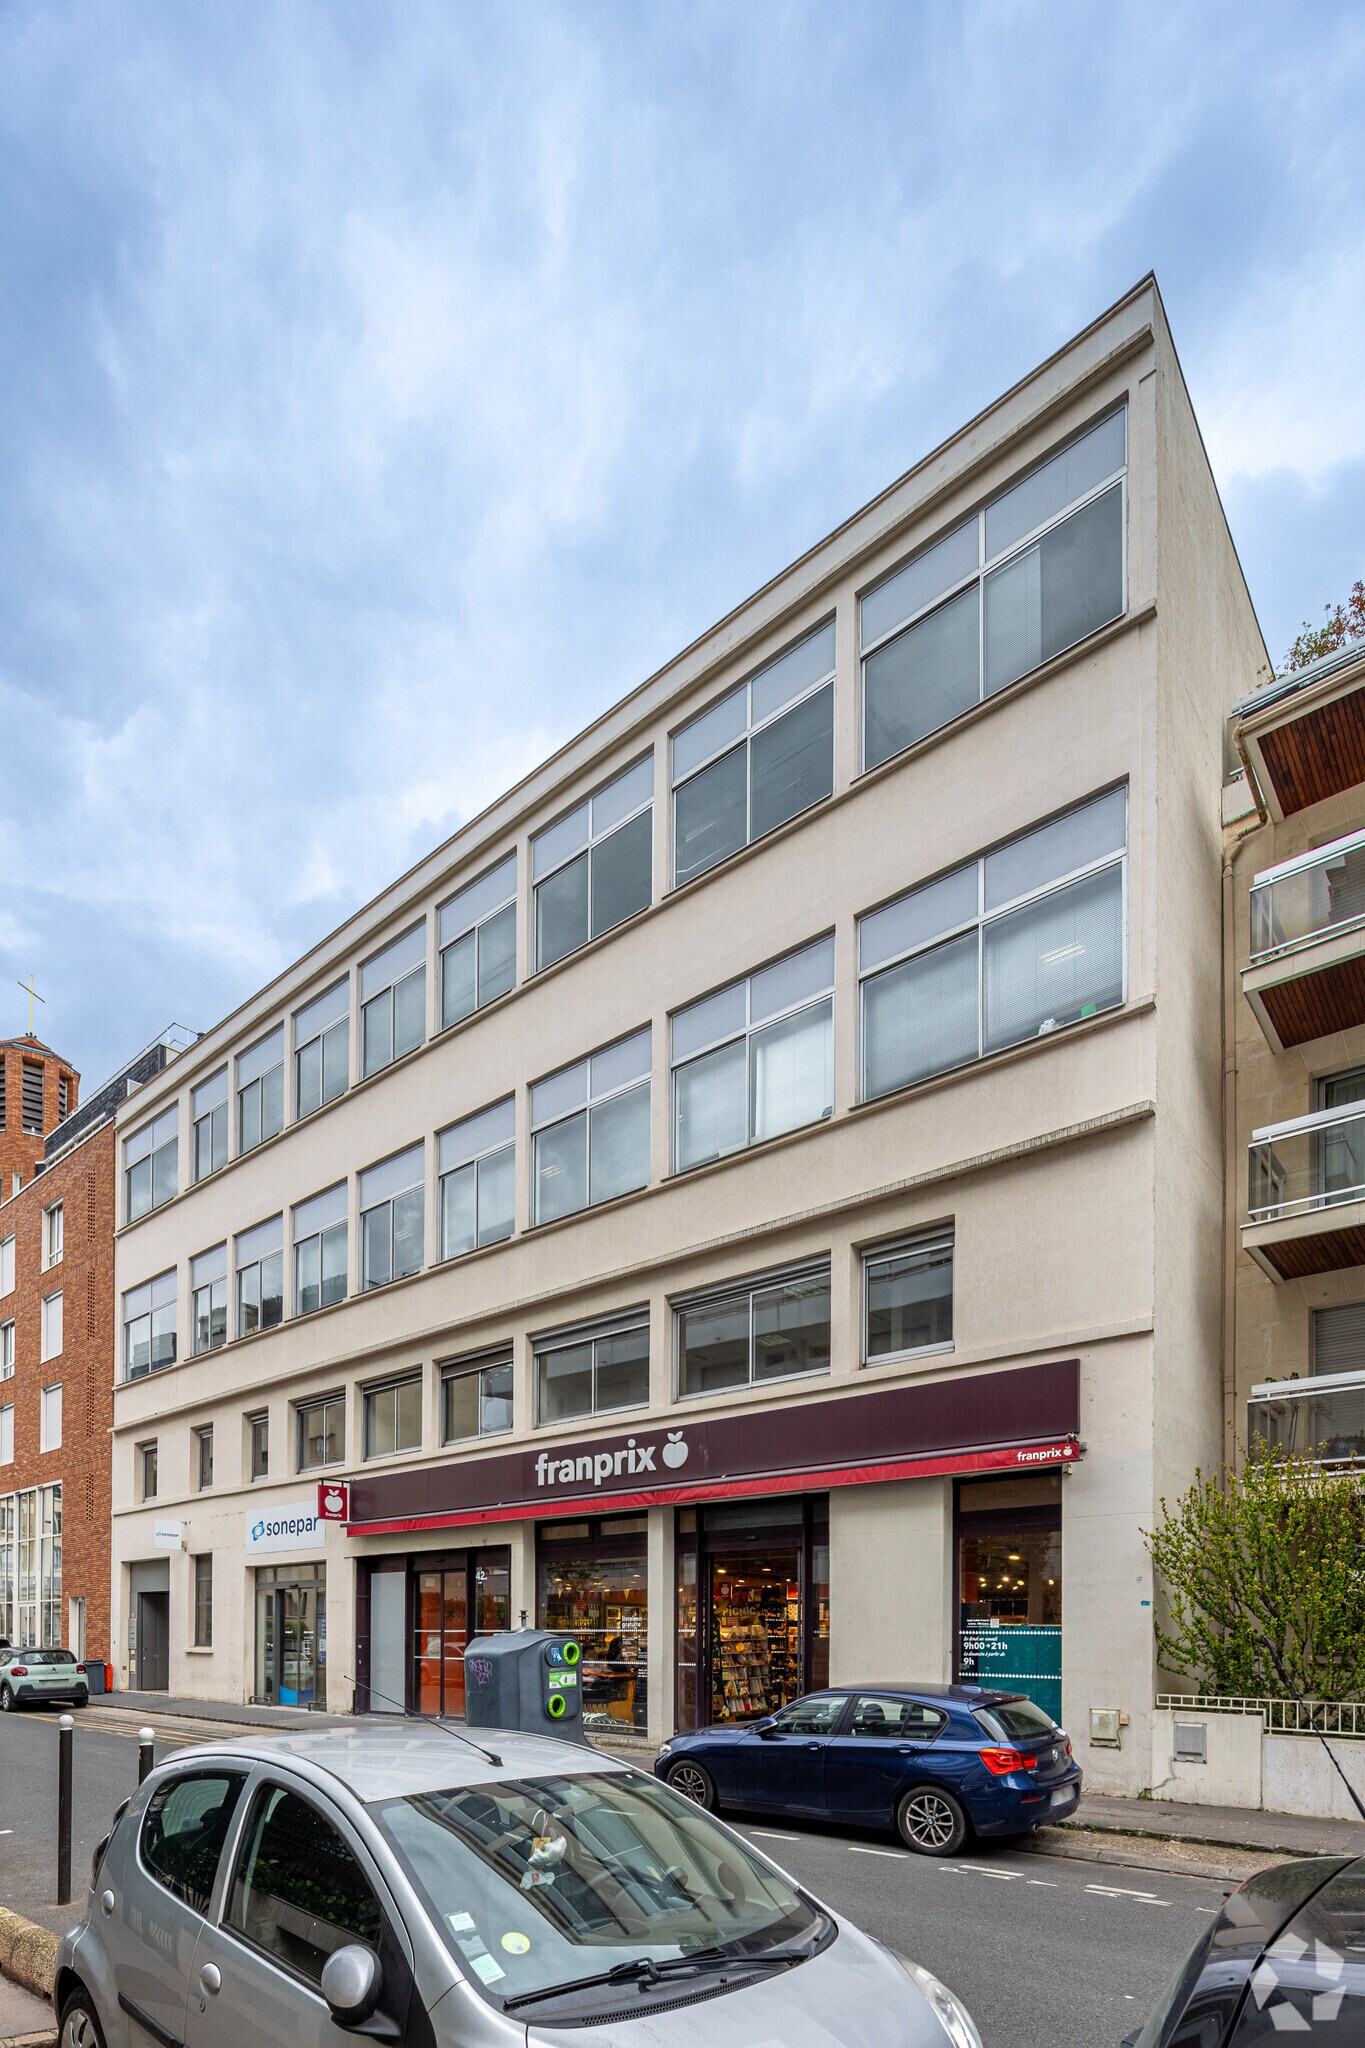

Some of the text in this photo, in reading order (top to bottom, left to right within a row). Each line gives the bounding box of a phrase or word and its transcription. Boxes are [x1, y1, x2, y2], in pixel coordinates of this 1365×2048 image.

[1017, 1447, 1062, 1461] franprix
[535, 1438, 657, 1486] franprix
[266, 1516, 319, 1537] sonepar
[963, 1641, 1008, 1650] 9h00 21h
[963, 1657, 975, 1666] 9h
